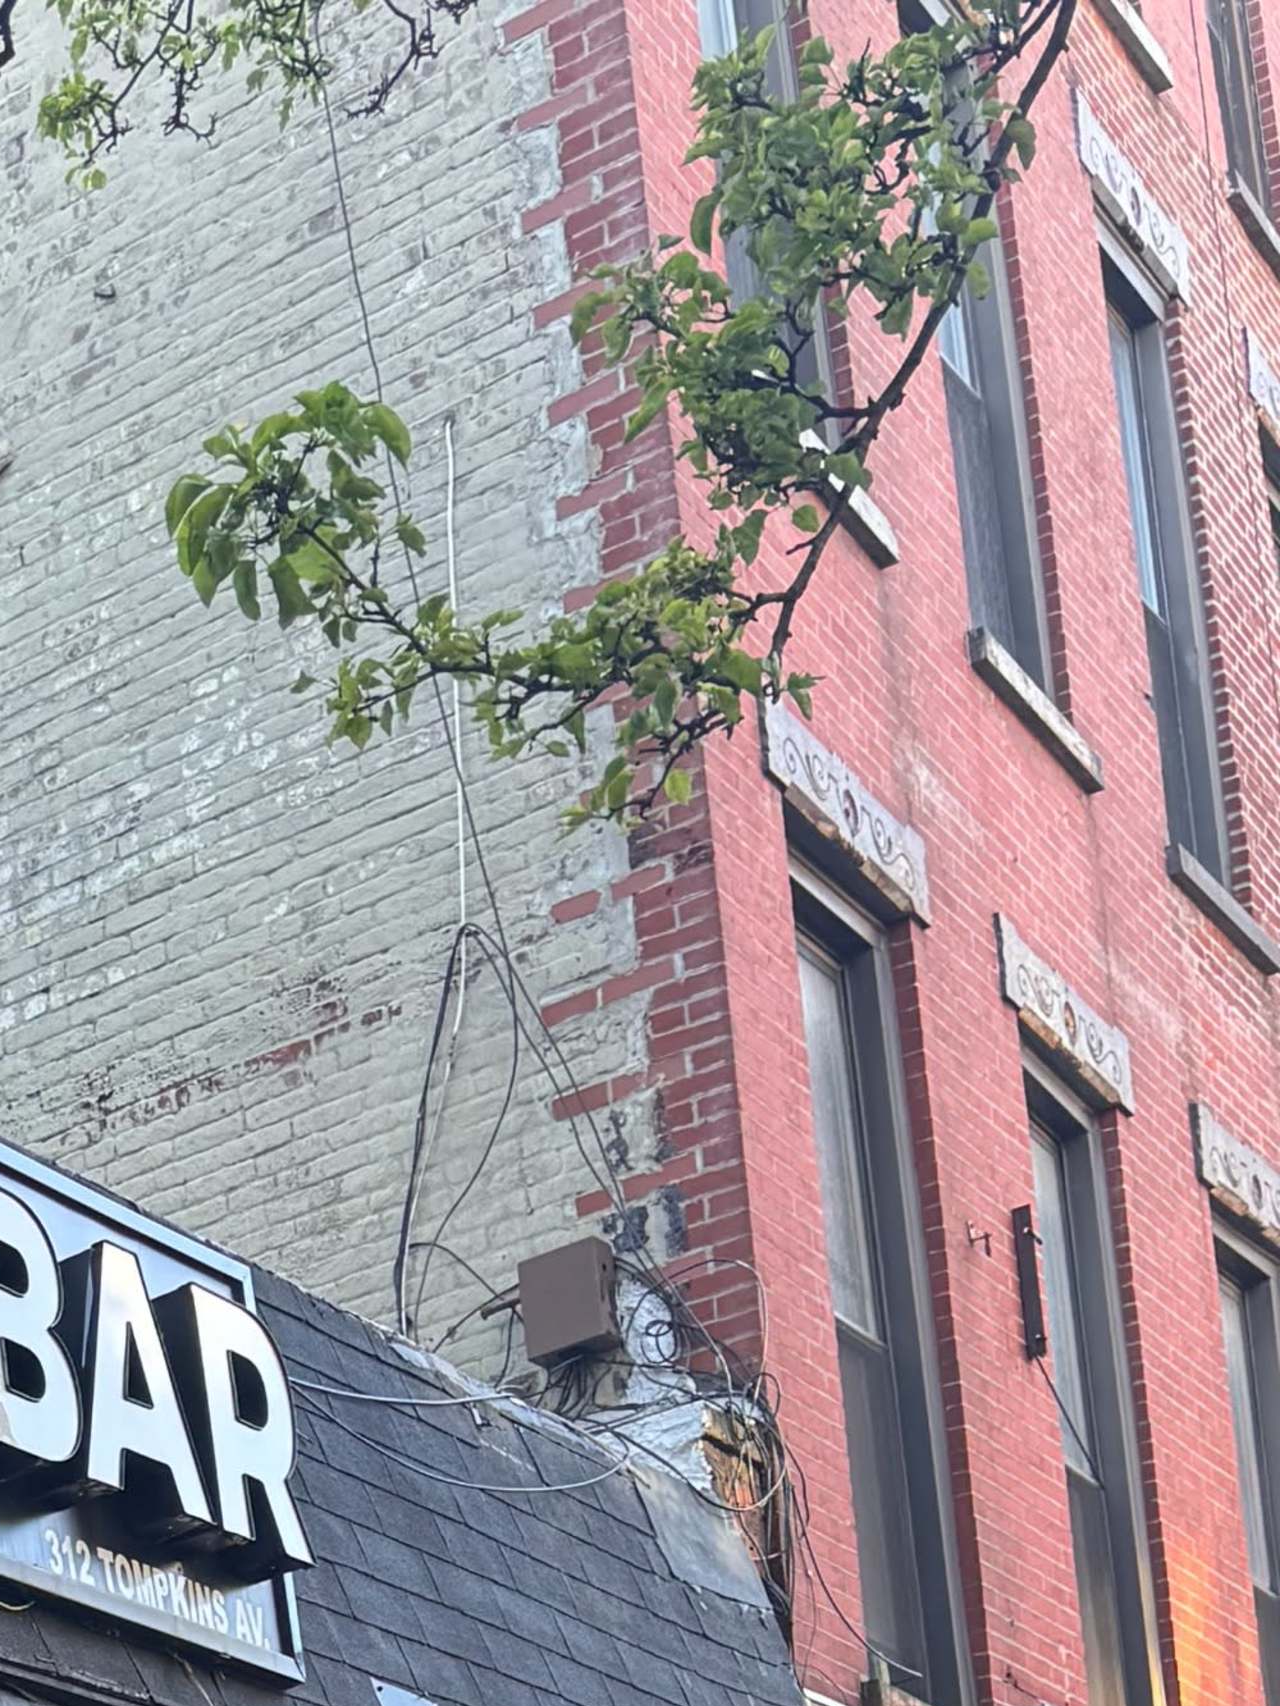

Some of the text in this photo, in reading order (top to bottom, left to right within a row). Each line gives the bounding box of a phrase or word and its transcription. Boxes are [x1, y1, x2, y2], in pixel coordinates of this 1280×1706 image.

[44, 1529, 272, 1650] 312 TOMPKINS AV.
